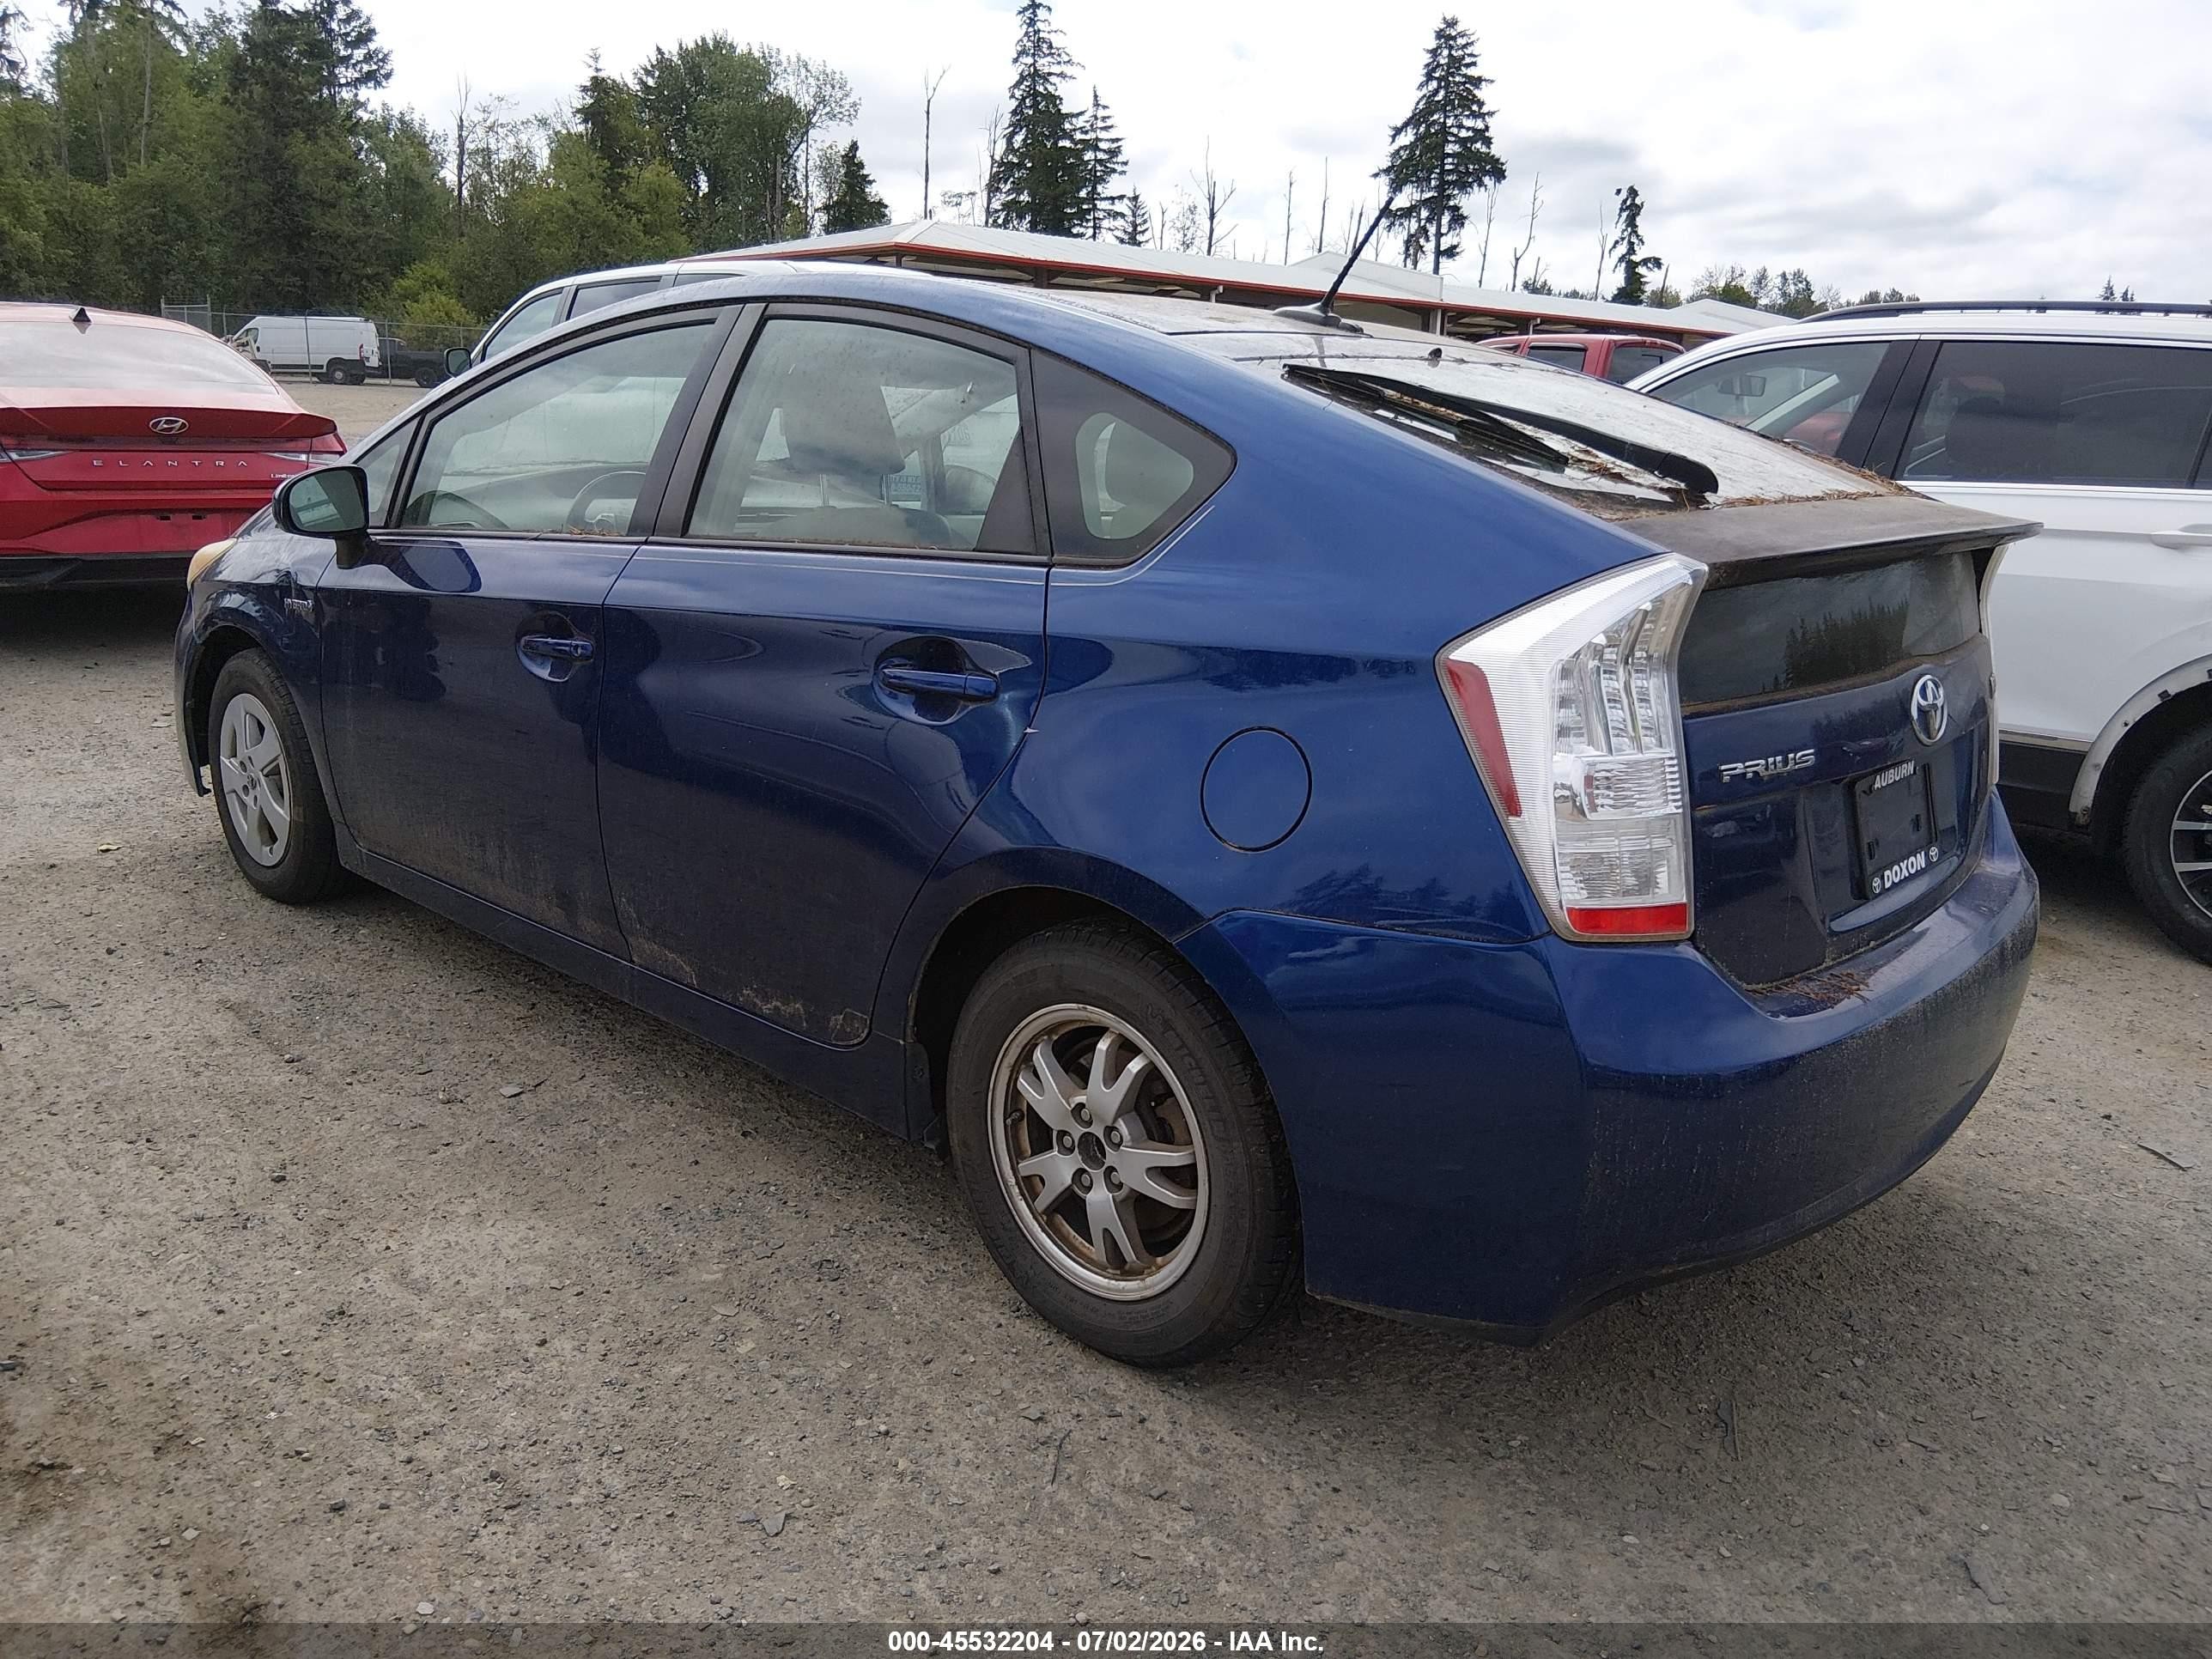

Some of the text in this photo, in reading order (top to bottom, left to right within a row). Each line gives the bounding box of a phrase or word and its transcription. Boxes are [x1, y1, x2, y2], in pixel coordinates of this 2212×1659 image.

[92, 459, 248, 468] ELANTRA
[1719, 749, 1815, 783] PRIUS
[1874, 761, 1915, 791] AUBURN
[1884, 851, 1925, 889] DOXON
